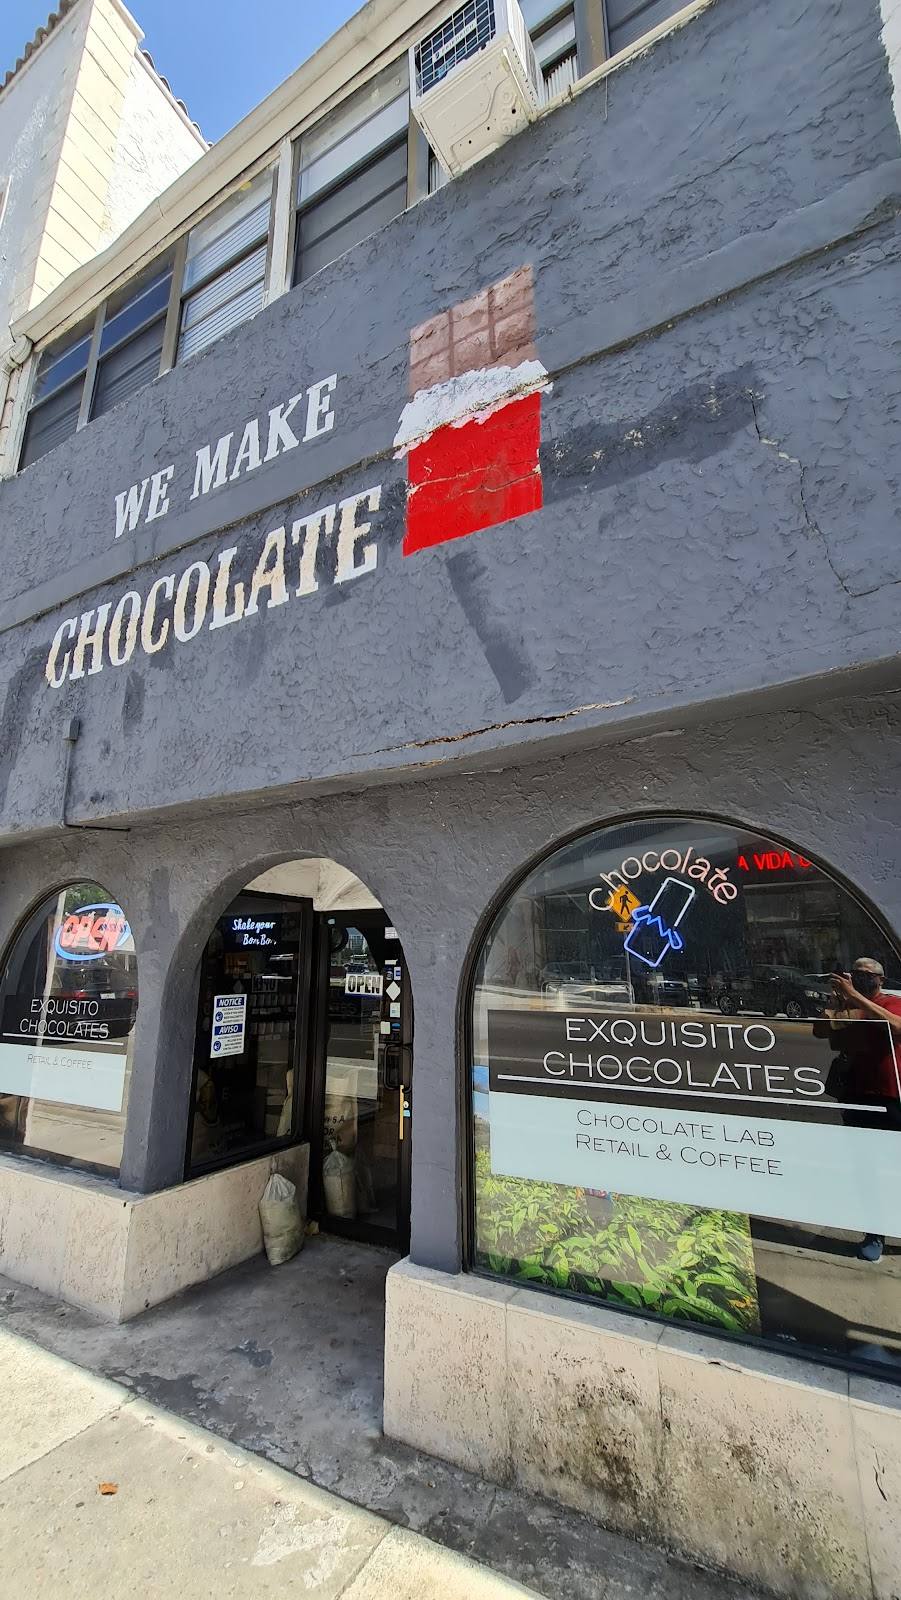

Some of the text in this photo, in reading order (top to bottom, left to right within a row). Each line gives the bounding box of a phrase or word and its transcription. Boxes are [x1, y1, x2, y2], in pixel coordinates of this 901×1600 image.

[113, 373, 338, 538] WE MAKE
[45, 485, 382, 689] CHOCOLATE
[588, 846, 738, 911] chocolate
[753, 851, 795, 870] VIDA
[60, 914, 124, 952] OPEN
[219, 997, 242, 1007] NOTICE
[347, 975, 381, 995] OPEN
[30, 998, 99, 1016] EXQUISITO
[19, 1018, 109, 1039] CHOCOLATES
[218, 1024, 239, 1035] AVISO
[565, 1018, 776, 1052] EXQUISITO
[543, 1051, 826, 1096] CHOCOLATES
[576, 1109, 775, 1147] CHOCOLATE LAB
[575, 1133, 784, 1176] RETAIL & COFFEE
